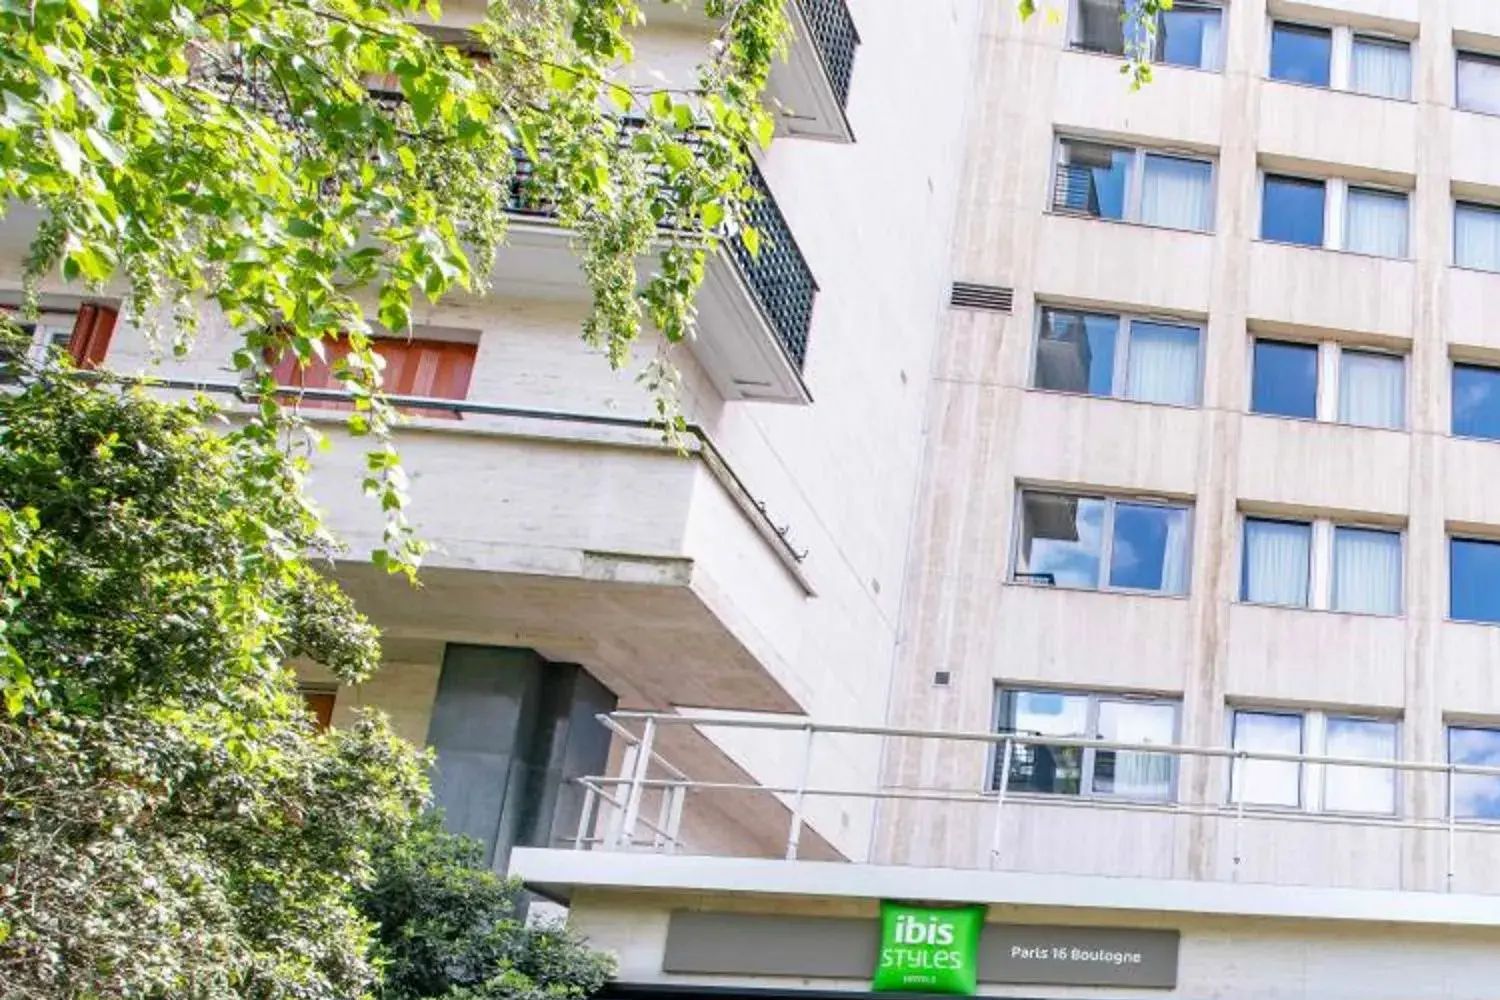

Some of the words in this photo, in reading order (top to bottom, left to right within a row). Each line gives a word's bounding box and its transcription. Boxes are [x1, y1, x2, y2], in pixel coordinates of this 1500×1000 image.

[894, 914, 954, 945] ibis
[1011, 945, 1049, 960] Paris
[1052, 947, 1067, 960] 16
[1071, 949, 1142, 965] Boulogne
